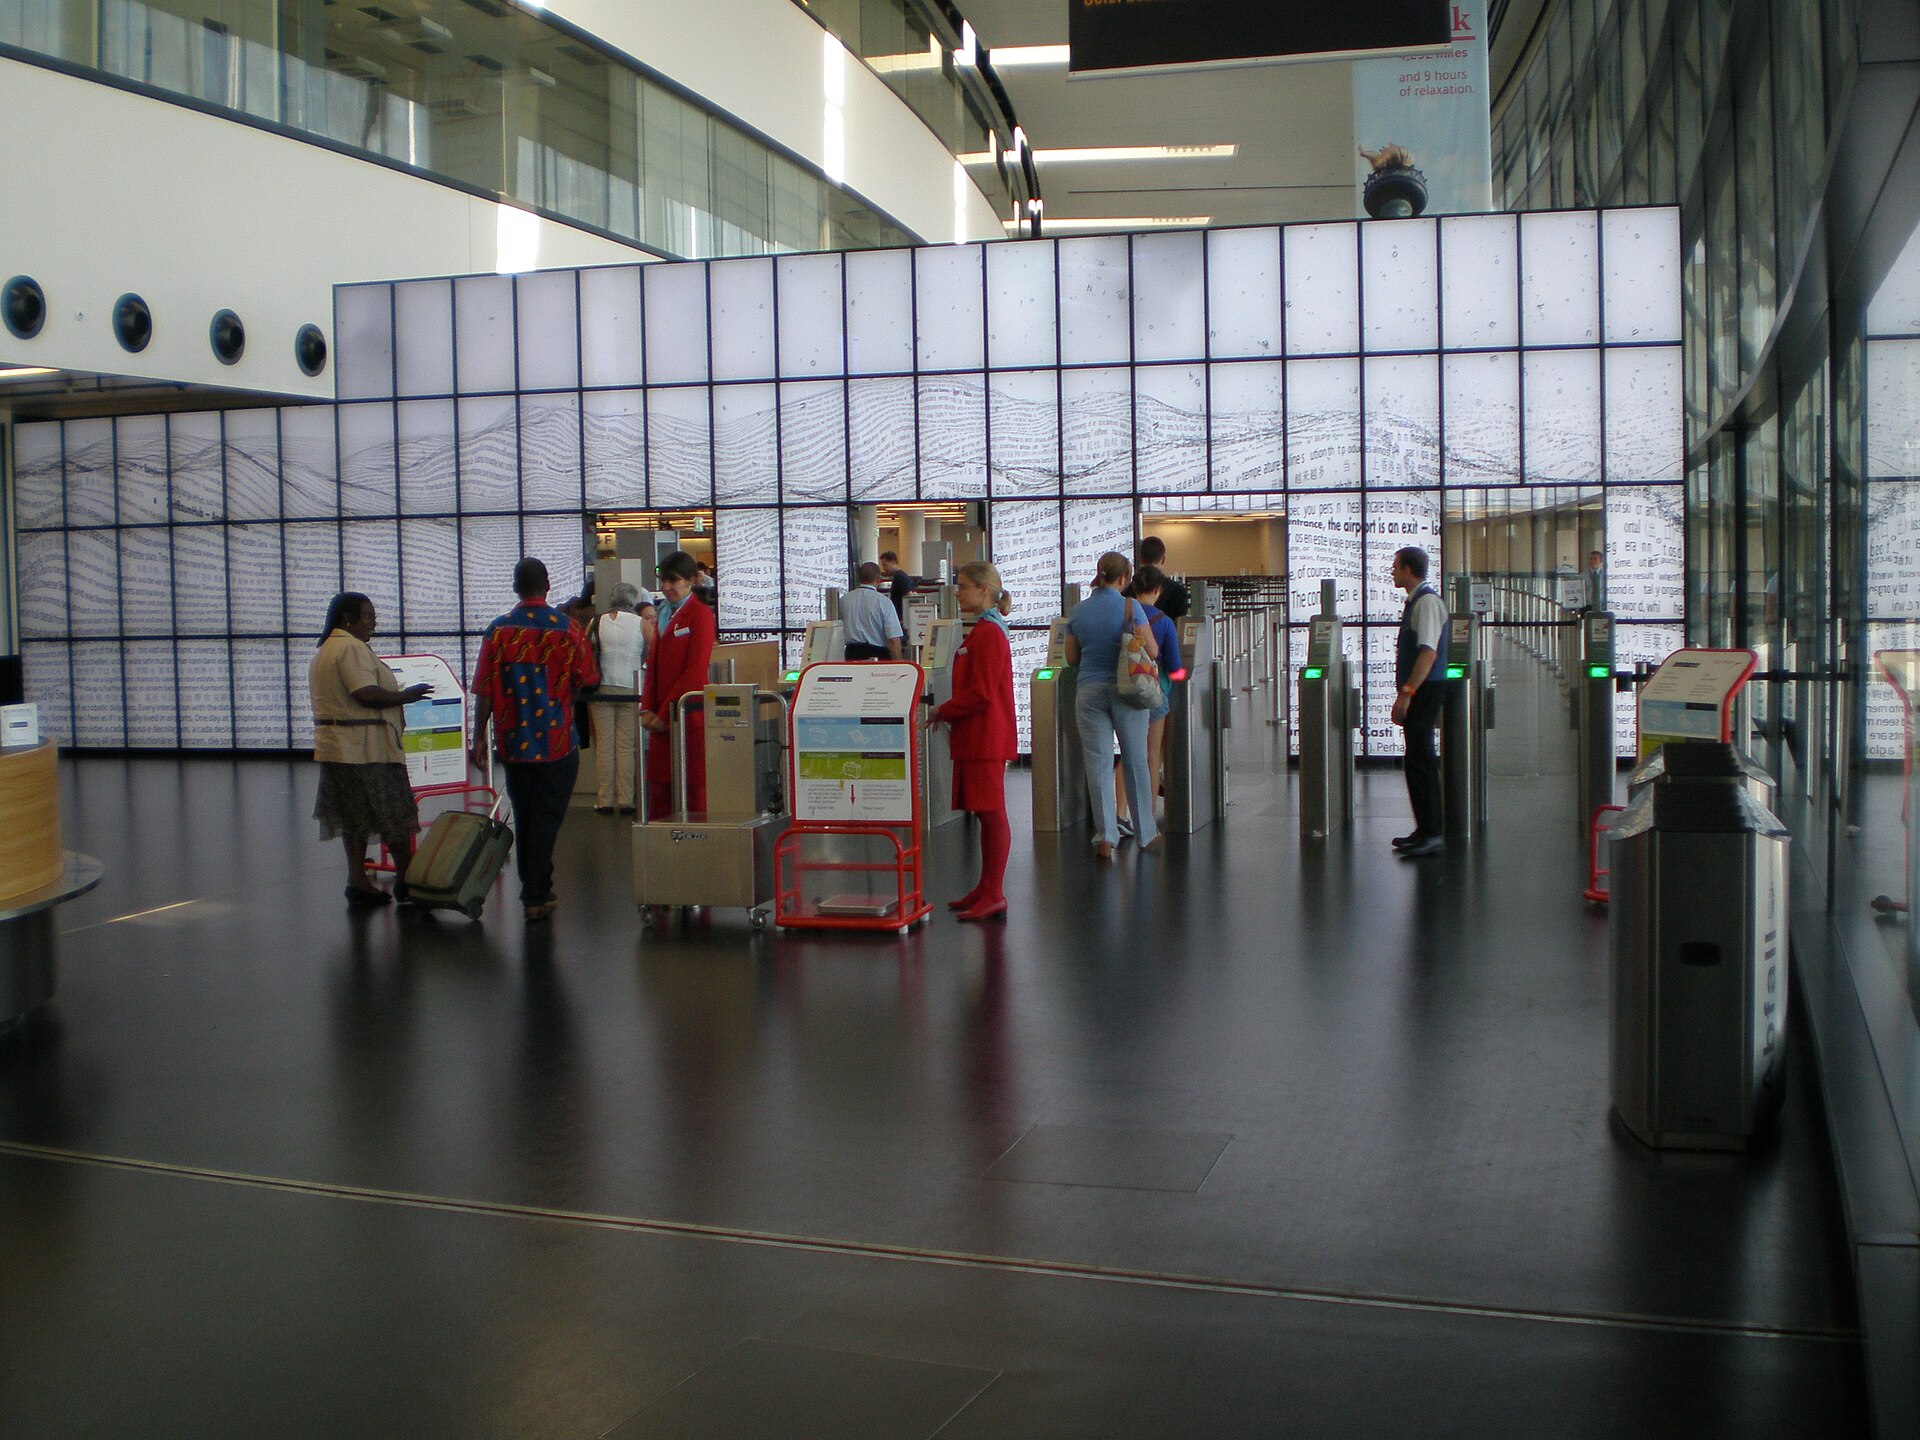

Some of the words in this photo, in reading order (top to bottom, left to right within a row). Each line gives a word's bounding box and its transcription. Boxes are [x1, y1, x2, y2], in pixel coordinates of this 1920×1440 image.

[1399, 70, 1421, 82] and
[1424, 71, 1431, 81] 9
[1435, 70, 1468, 81] hours
[1400, 86, 1412, 97] of
[1414, 84, 1475, 96] relaxation.
[1328, 517, 1341, 531] the
[1378, 520, 1385, 534] is
[1388, 522, 1399, 534] an
[1402, 519, 1418, 535] exit
